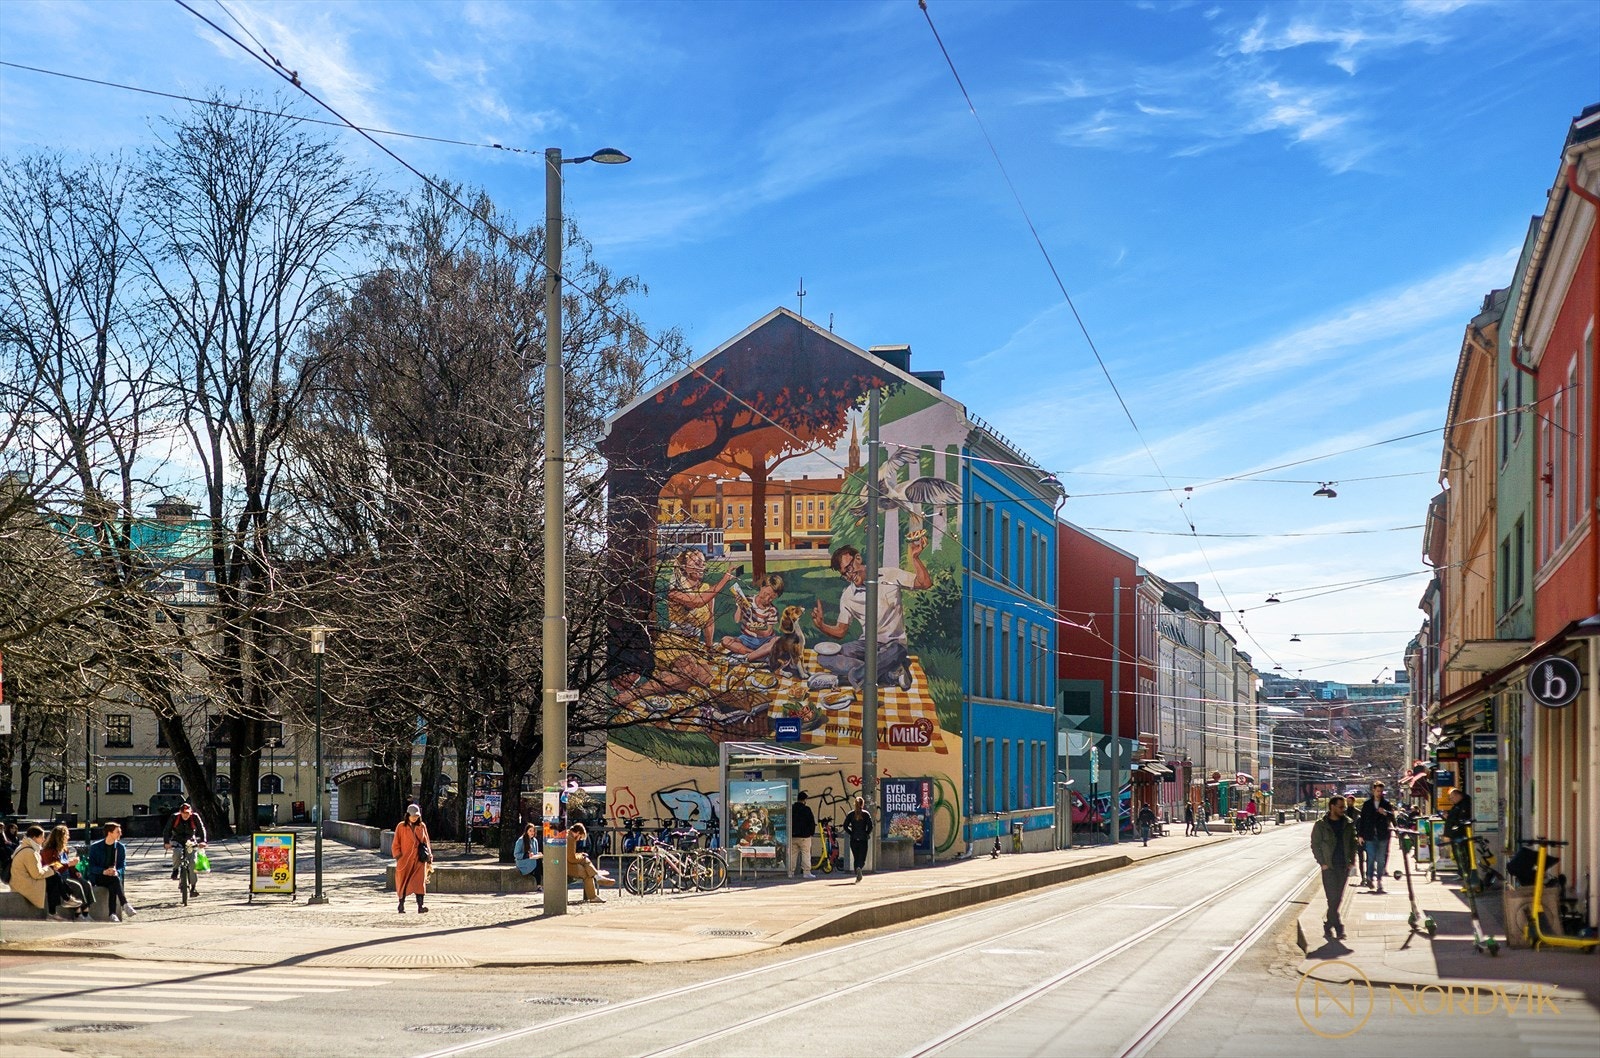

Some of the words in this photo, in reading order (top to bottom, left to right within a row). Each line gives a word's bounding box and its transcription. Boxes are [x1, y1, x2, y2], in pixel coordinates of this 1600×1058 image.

[1542, 664, 1567, 699] b
[892, 727, 929, 743] Mills
[886, 784, 906, 793] EVEN
[886, 794, 917, 803] BIGGER
[886, 803, 918, 812] BIGONE
